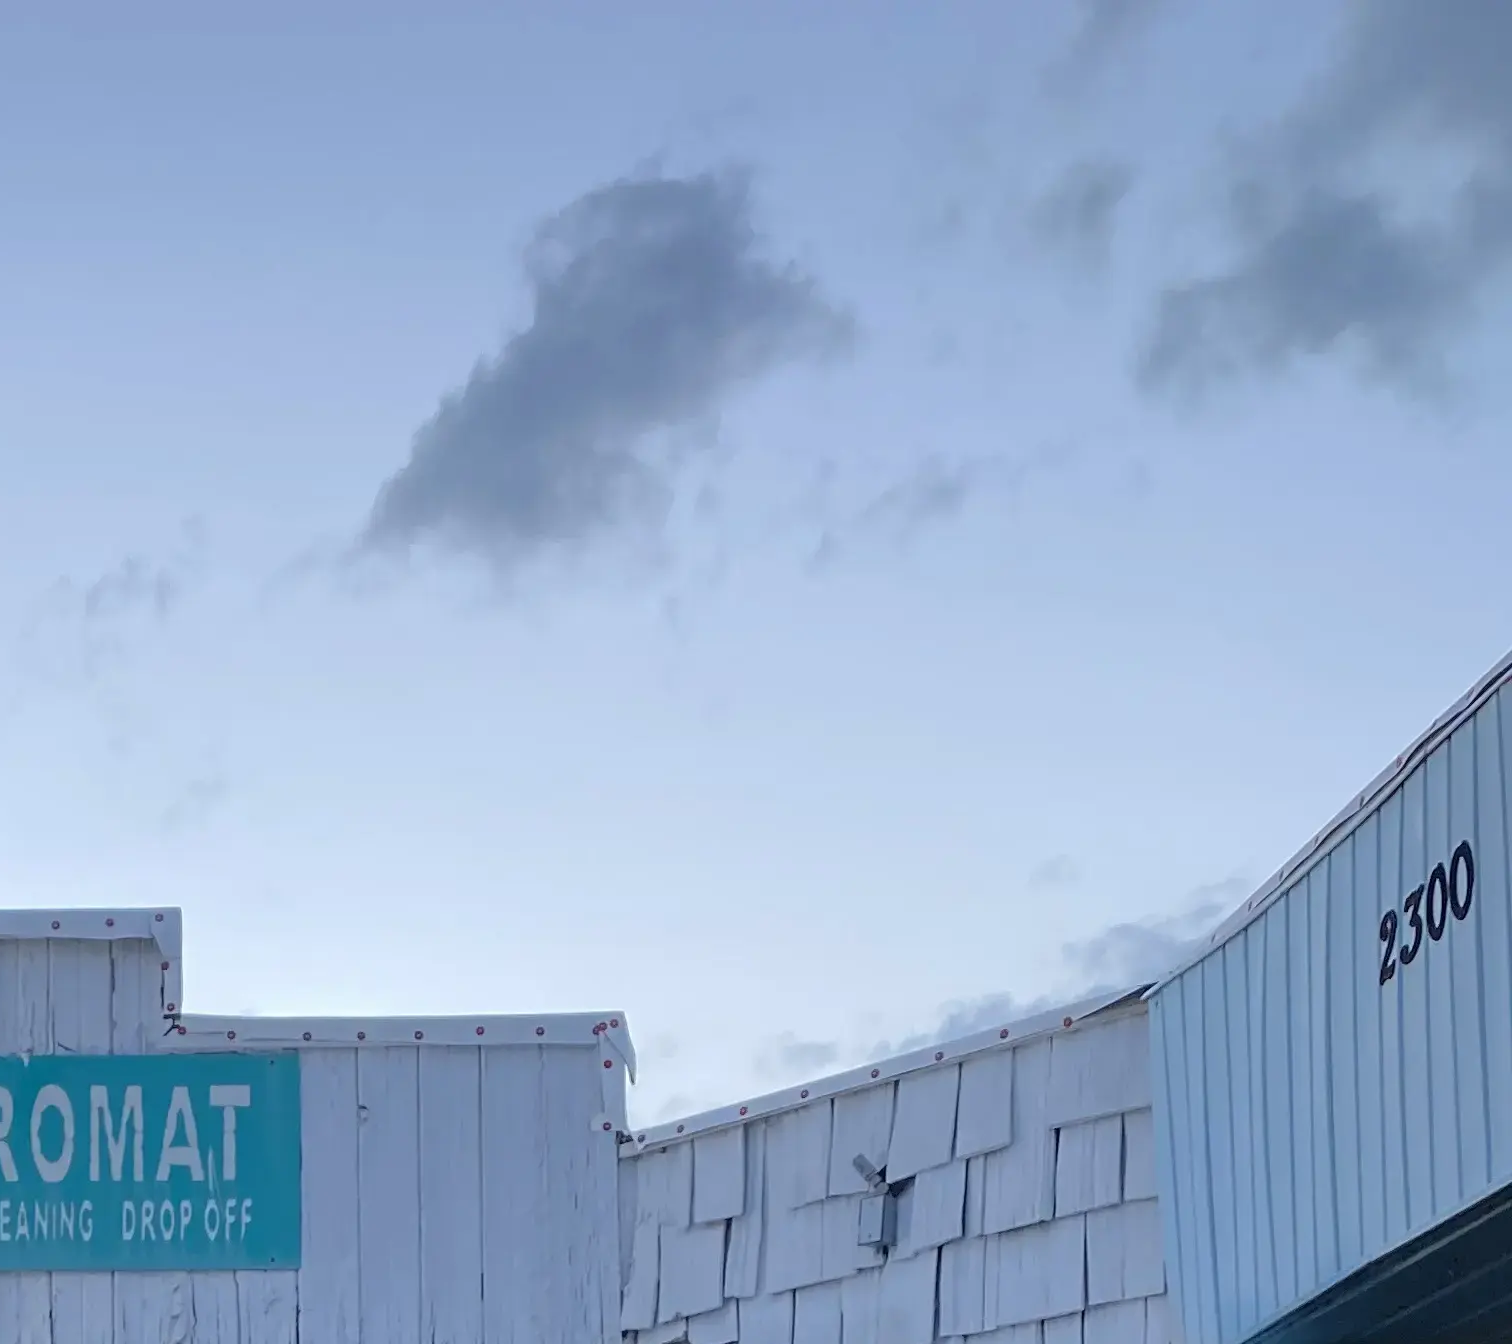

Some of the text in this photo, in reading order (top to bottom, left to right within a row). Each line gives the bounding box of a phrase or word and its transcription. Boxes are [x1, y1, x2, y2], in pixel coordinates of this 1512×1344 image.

[1379, 839, 1475, 986] 2300
[122, 1199, 193, 1242] DROP
[204, 1198, 253, 1242] OFF
